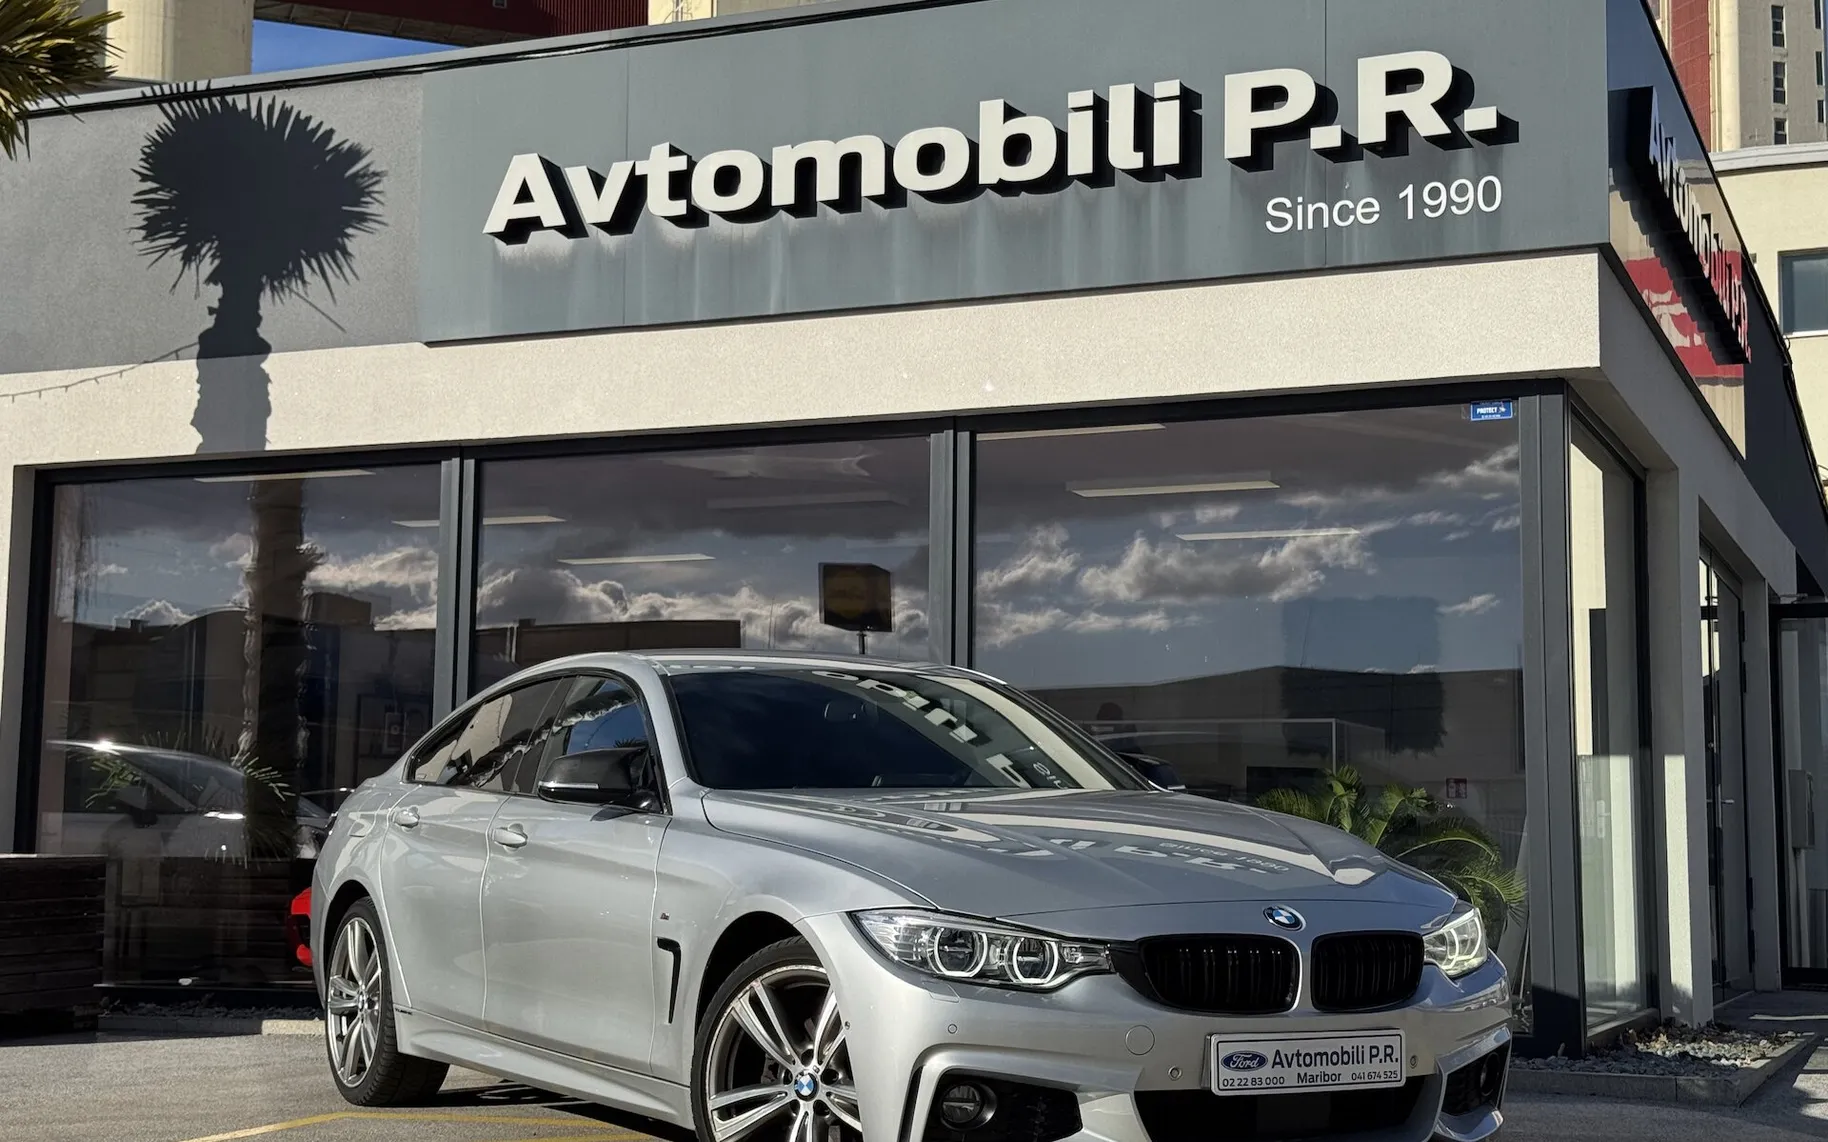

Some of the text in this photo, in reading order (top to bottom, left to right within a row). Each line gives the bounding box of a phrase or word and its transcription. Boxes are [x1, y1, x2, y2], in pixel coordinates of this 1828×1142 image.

[483, 50, 1498, 235] Avtomobili P.R.
[1265, 174, 1502, 234] Since 1990
[1271, 1044, 1399, 1070] Avtomobili P.R.
[1222, 1076, 1285, 1088] 02 22 83 000
[1296, 1070, 1342, 1084] Maribor
[1351, 1070, 1399, 1081] 041 674 525
